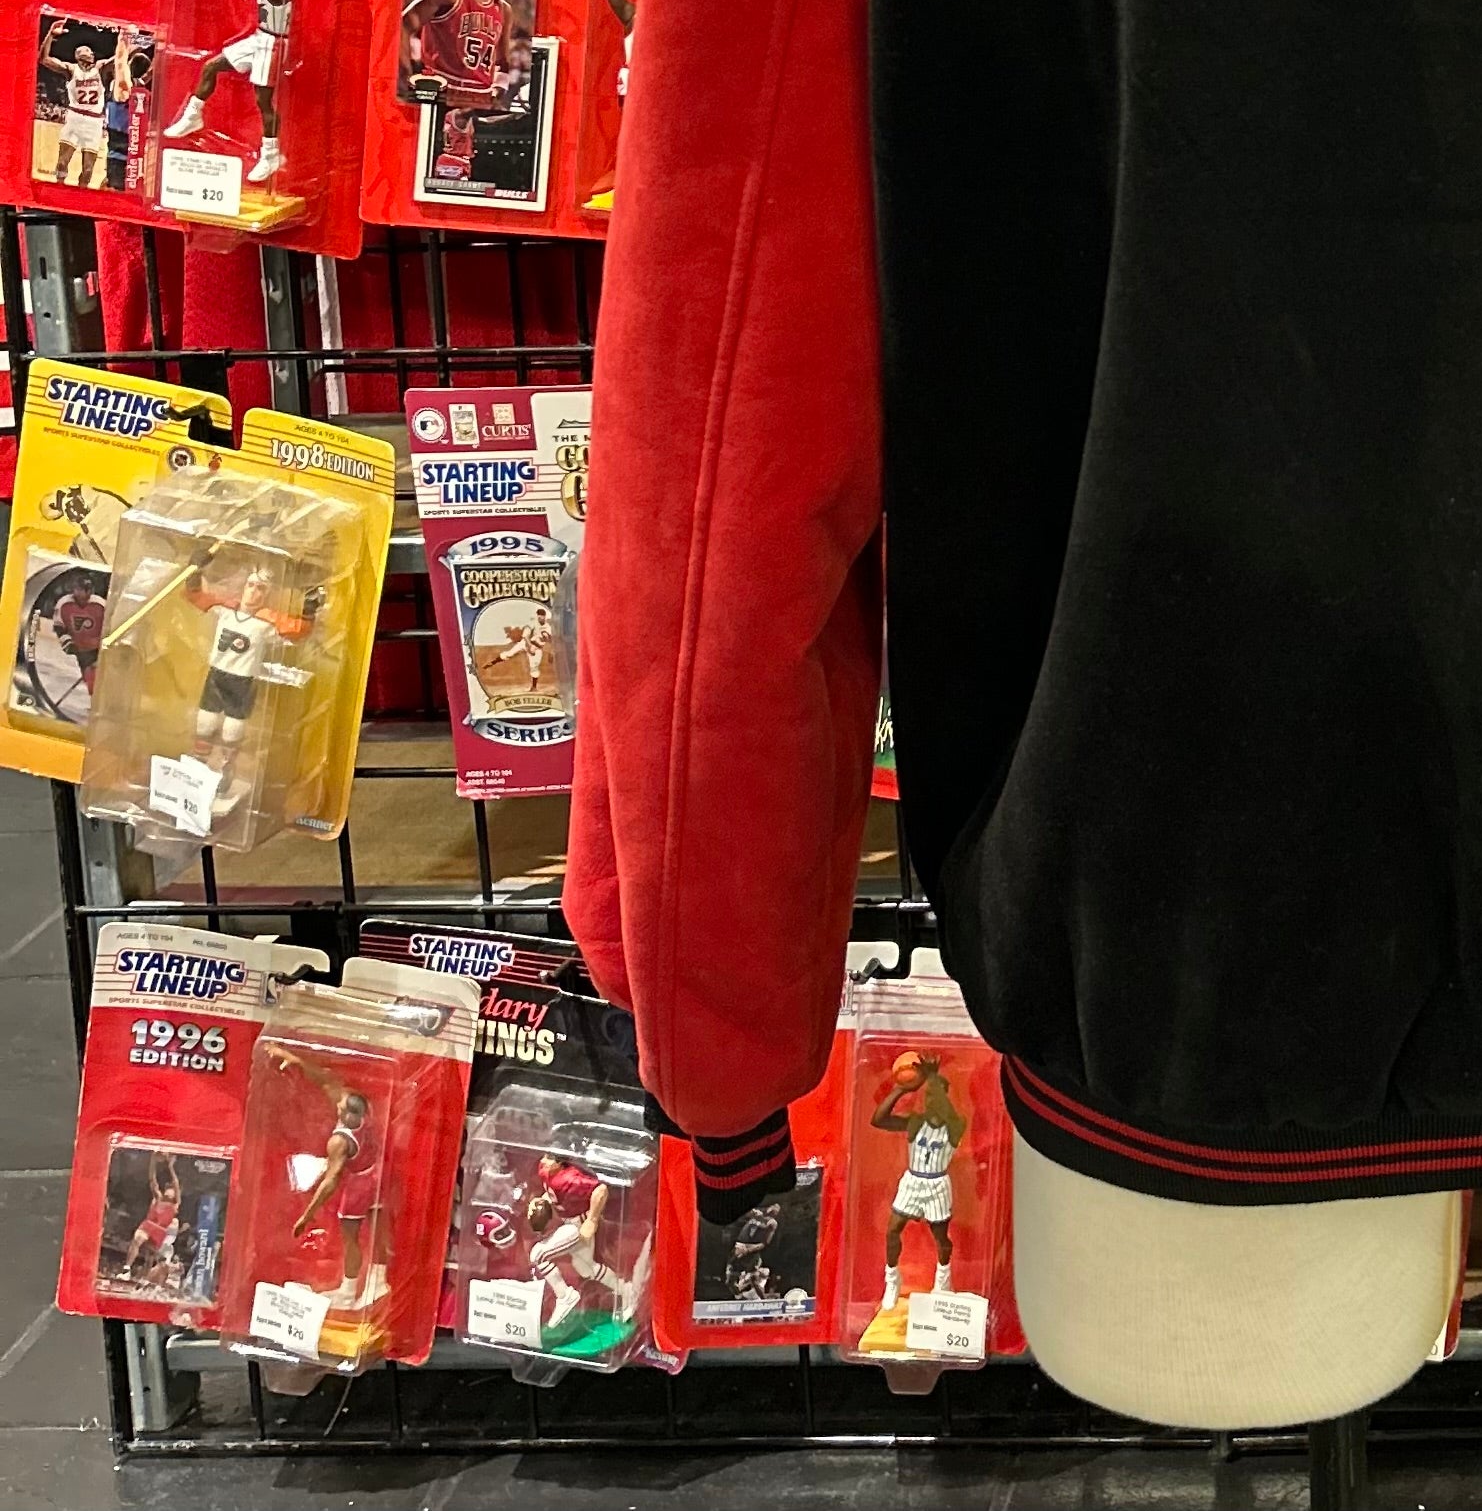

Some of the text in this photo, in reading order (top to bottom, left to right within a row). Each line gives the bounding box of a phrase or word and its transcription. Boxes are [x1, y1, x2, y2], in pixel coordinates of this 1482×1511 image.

[464, 37, 496, 75] 54
[78, 89, 99, 105] 22
[202, 188, 224, 202] $20
[47, 378, 172, 422] STARTING
[63, 404, 155, 438] LINEUP
[481, 423, 531, 437] CURTIS
[270, 438, 375, 481] 1998 EDITION
[422, 461, 536, 484] STARTING
[443, 482, 524, 504] LINEUP
[469, 536, 545, 556] 1995
[460, 567, 561, 585] COOPERSTOWN
[462, 582, 557, 609] COLLECTION
[504, 697, 553, 707] BOB FELLER
[486, 720, 574, 743] SERIES
[183, 798, 199, 816] $20
[411, 936, 514, 964] STARTING
[117, 951, 245, 984] STARTING
[426, 955, 500, 978] LINEUP
[135, 972, 228, 1000] LINEUP
[130, 1019, 228, 1055] 1996
[130, 1048, 224, 1072] EDITION
[504, 1322, 527, 1338] $20
[946, 1333, 970, 1348] $20
